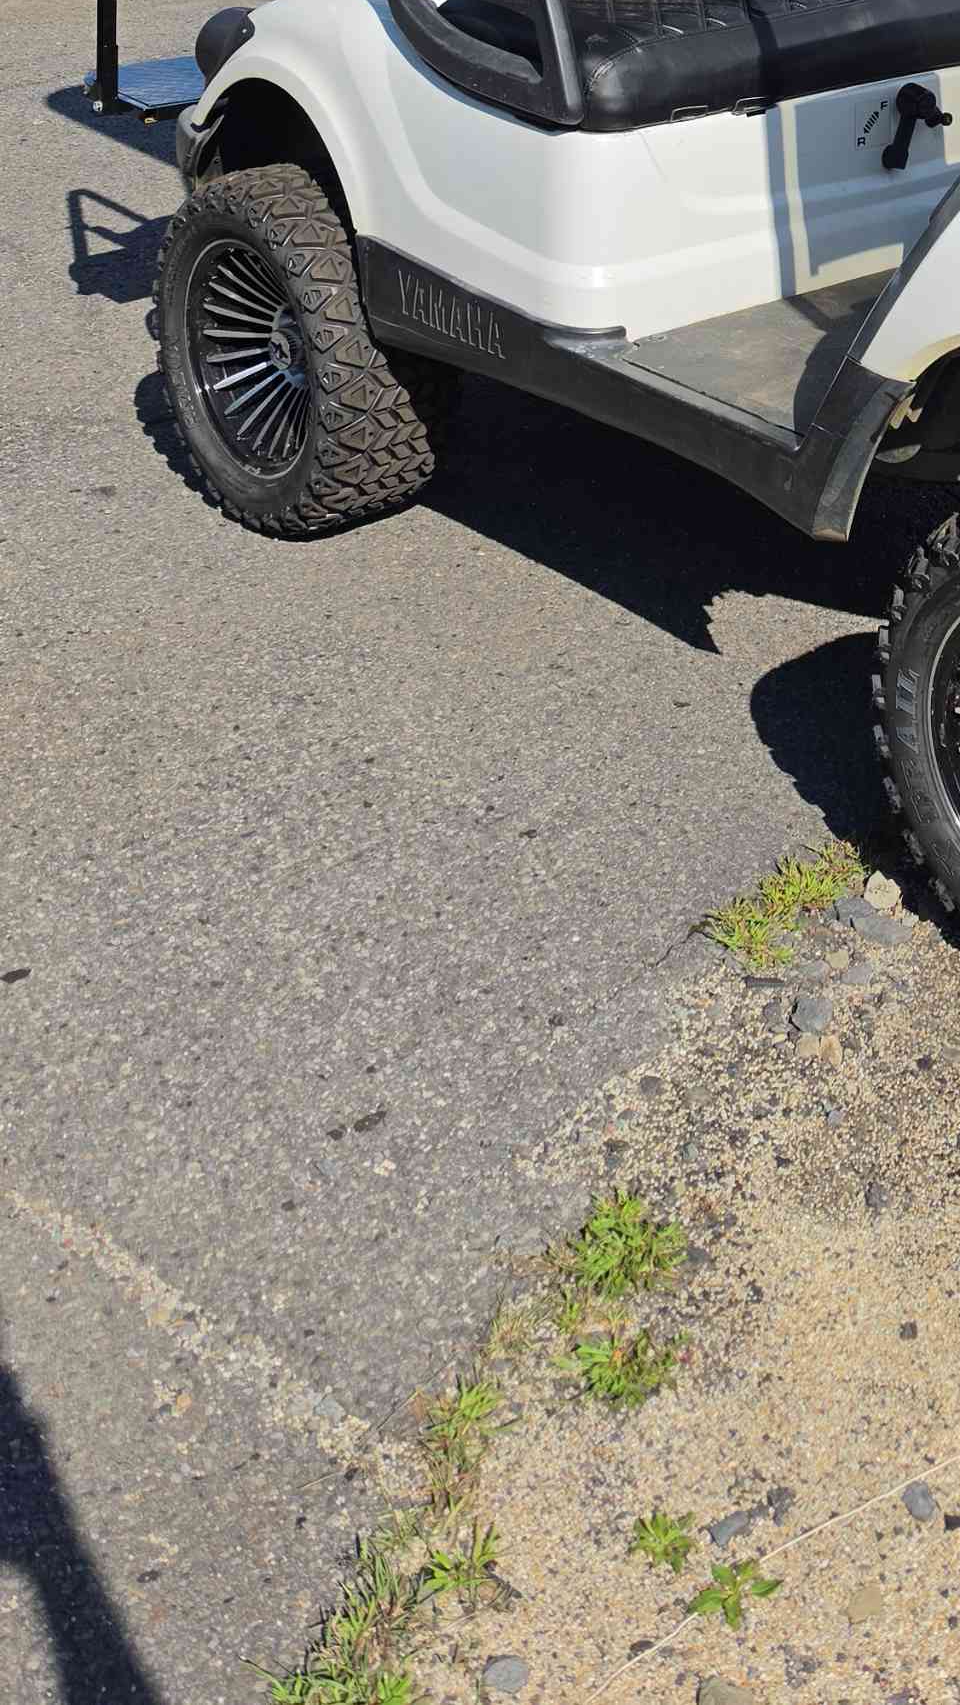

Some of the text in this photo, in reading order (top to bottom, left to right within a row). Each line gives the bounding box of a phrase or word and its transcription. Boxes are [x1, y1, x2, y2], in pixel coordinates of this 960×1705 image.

[880, 100, 888, 111] F
[857, 136, 866, 147] R
[398, 270, 506, 360] YAMAHA
